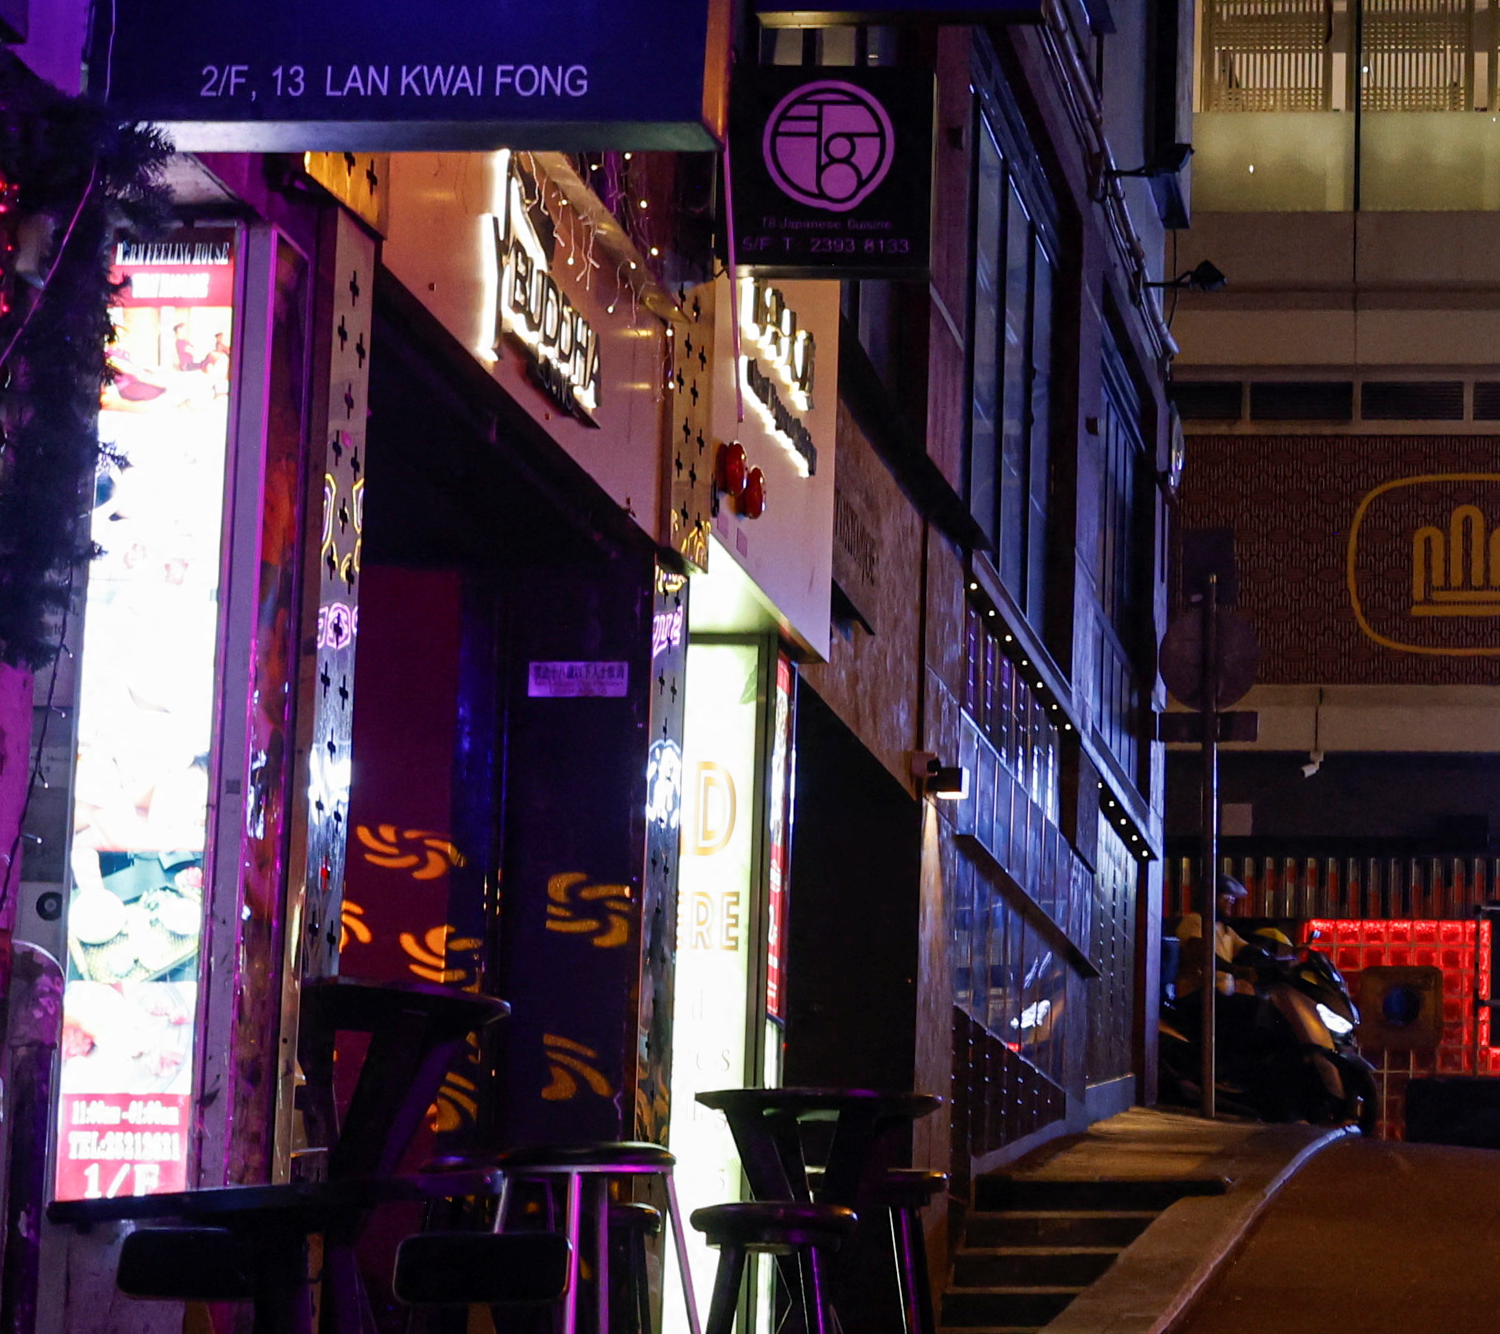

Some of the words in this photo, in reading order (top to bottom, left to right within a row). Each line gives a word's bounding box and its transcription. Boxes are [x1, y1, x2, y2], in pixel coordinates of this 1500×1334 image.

[271, 65, 306, 98] 13
[325, 64, 390, 98] LAN
[400, 64, 484, 98] KWAI
[495, 64, 589, 98] FONG
[779, 216, 842, 231] Japanese
[781, 237, 793, 252] T
[810, 237, 856, 254] 2393
